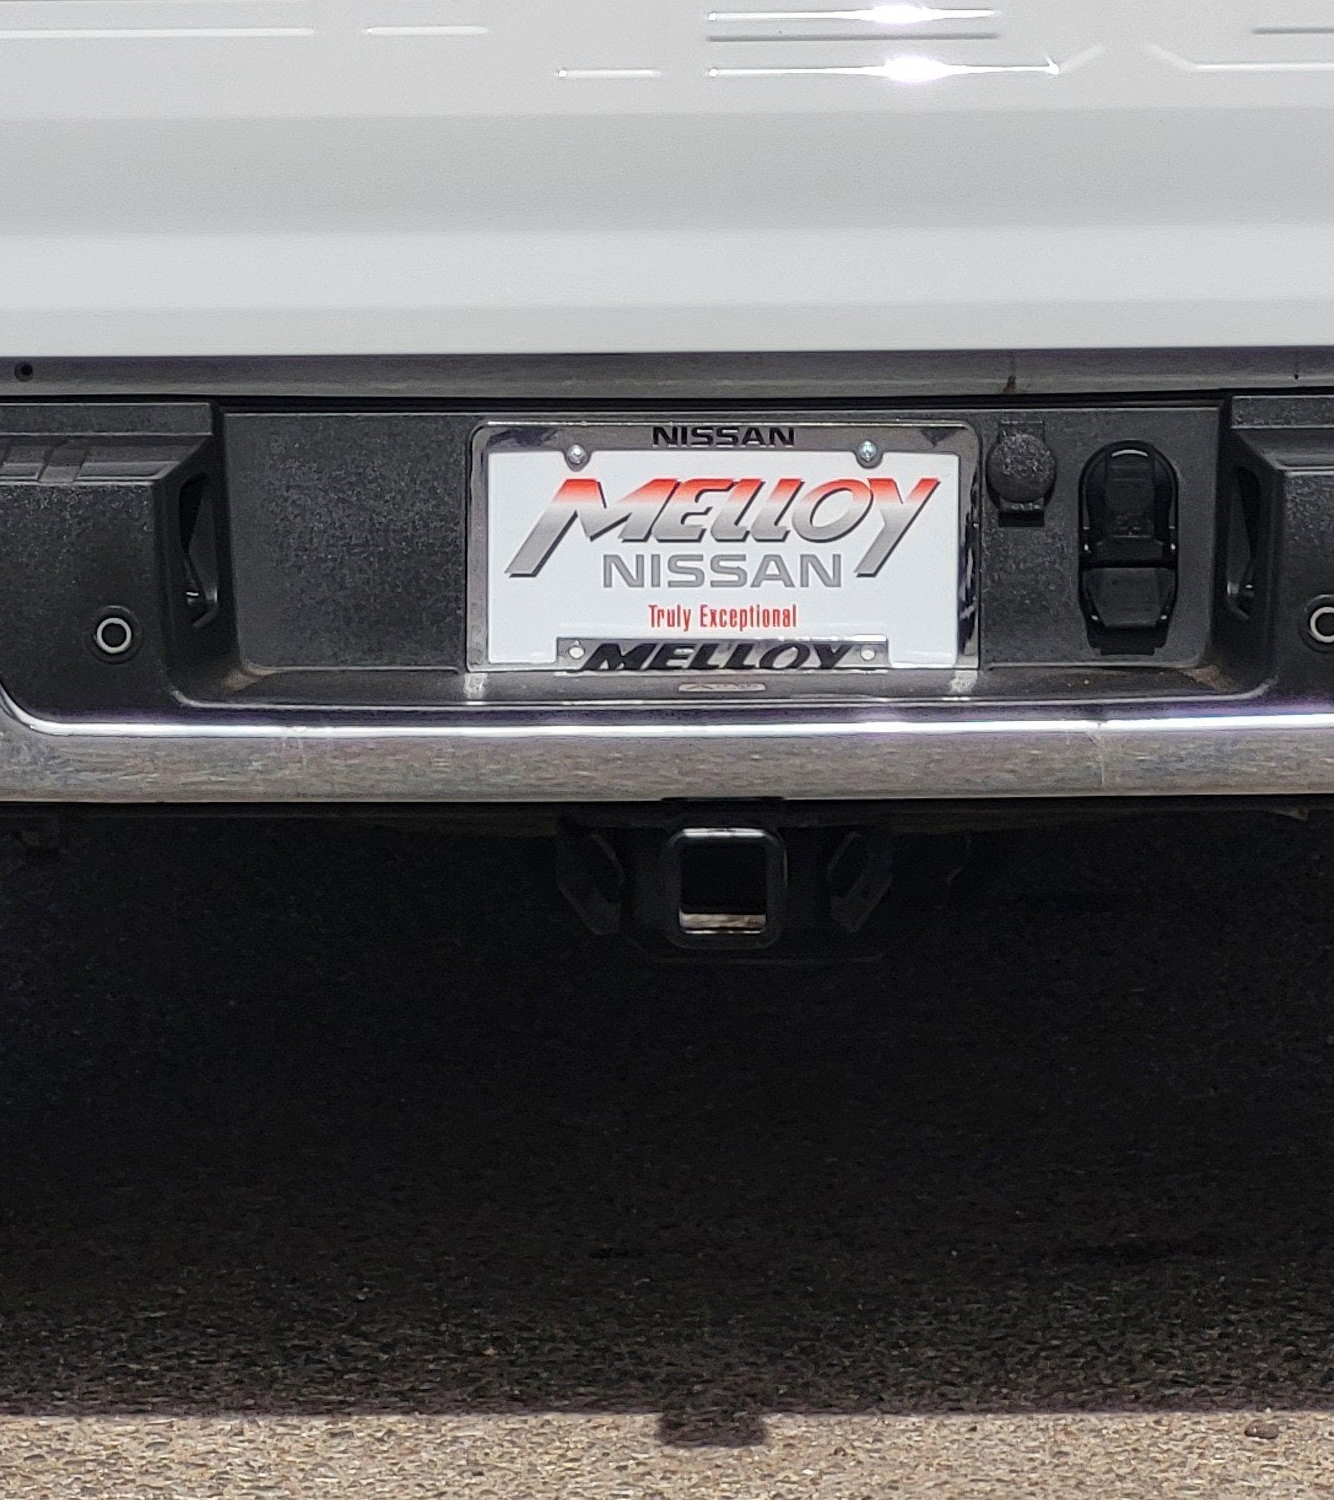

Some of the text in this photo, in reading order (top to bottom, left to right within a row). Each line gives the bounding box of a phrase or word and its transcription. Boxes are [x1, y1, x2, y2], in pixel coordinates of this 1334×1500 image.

[652, 425, 796, 447] NISSAN
[504, 477, 941, 578] MELLOY
[603, 553, 842, 588] NISSAN
[648, 603, 798, 632] Truly Exceptional
[578, 642, 848, 671] MELLOY
